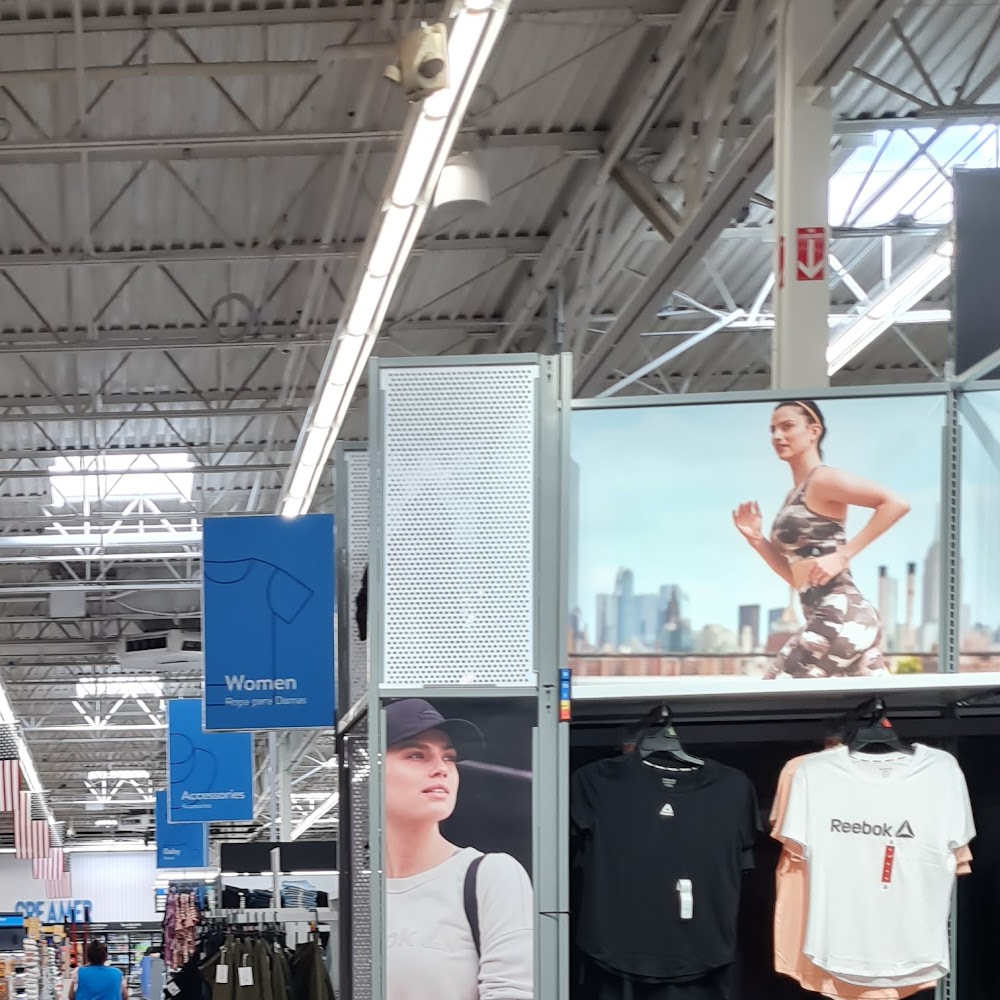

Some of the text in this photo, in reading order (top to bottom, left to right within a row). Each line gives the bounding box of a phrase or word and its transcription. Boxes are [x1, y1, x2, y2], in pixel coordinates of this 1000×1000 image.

[224, 674, 297, 691] Women
[181, 790, 246, 800] Accessories
[830, 818, 893, 838] Reebok
